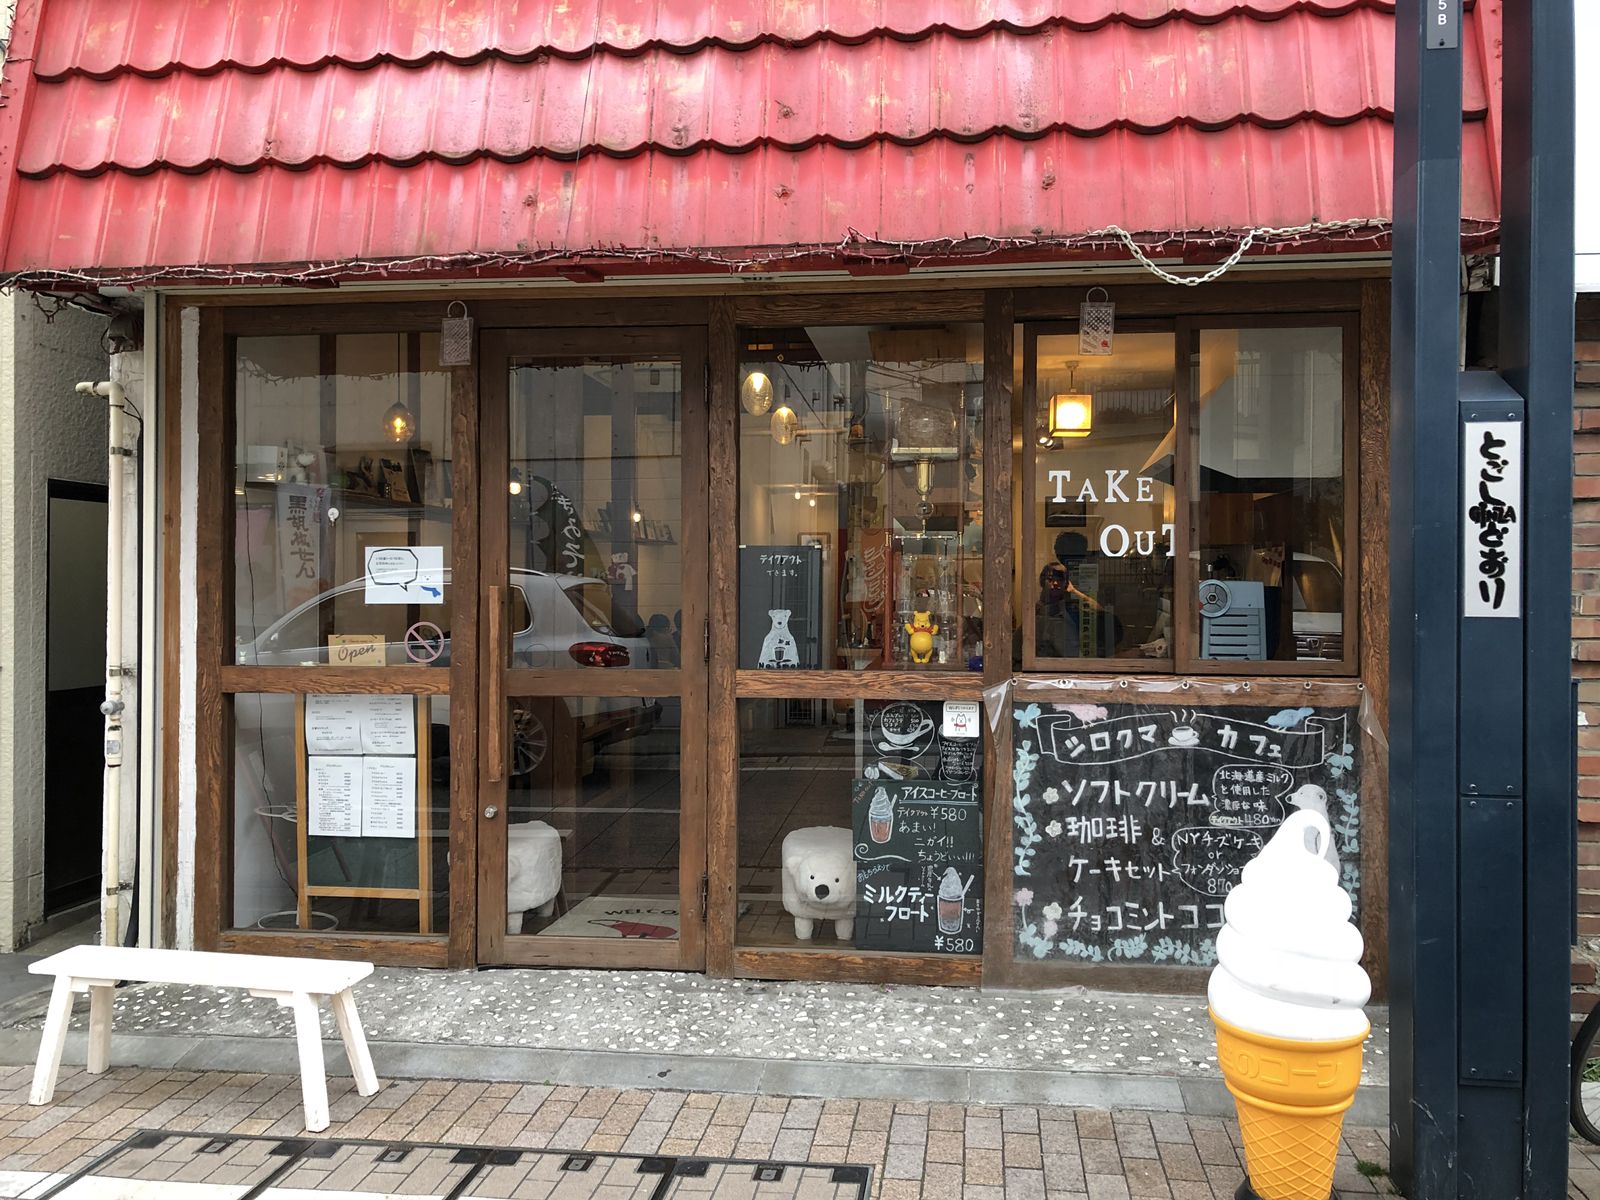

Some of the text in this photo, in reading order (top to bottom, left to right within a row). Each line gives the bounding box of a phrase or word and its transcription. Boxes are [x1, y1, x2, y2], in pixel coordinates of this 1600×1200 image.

[1048, 470, 1154, 502] TAKE
[760, 554, 802, 565] テイクアウト
[337, 645, 376, 663] Open
[1064, 724, 1282, 758] シロクマ カフェ
[1219, 769, 1289, 784] 北海道産ミルク
[901, 786, 978, 801] アイスコーヒーフロート
[1061, 779, 1209, 809] ソフトクリーム
[930, 806, 967, 822] ¥580
[1066, 815, 1165, 846] 珈琲 &
[1208, 850, 1223, 859] or
[1068, 855, 1171, 883] ケーキセット
[1181, 862, 1245, 876] フォンダンショ
[863, 884, 934, 904] ミルクティー
[885, 904, 929, 922] フロート
[935, 935, 974, 952] ¥580
